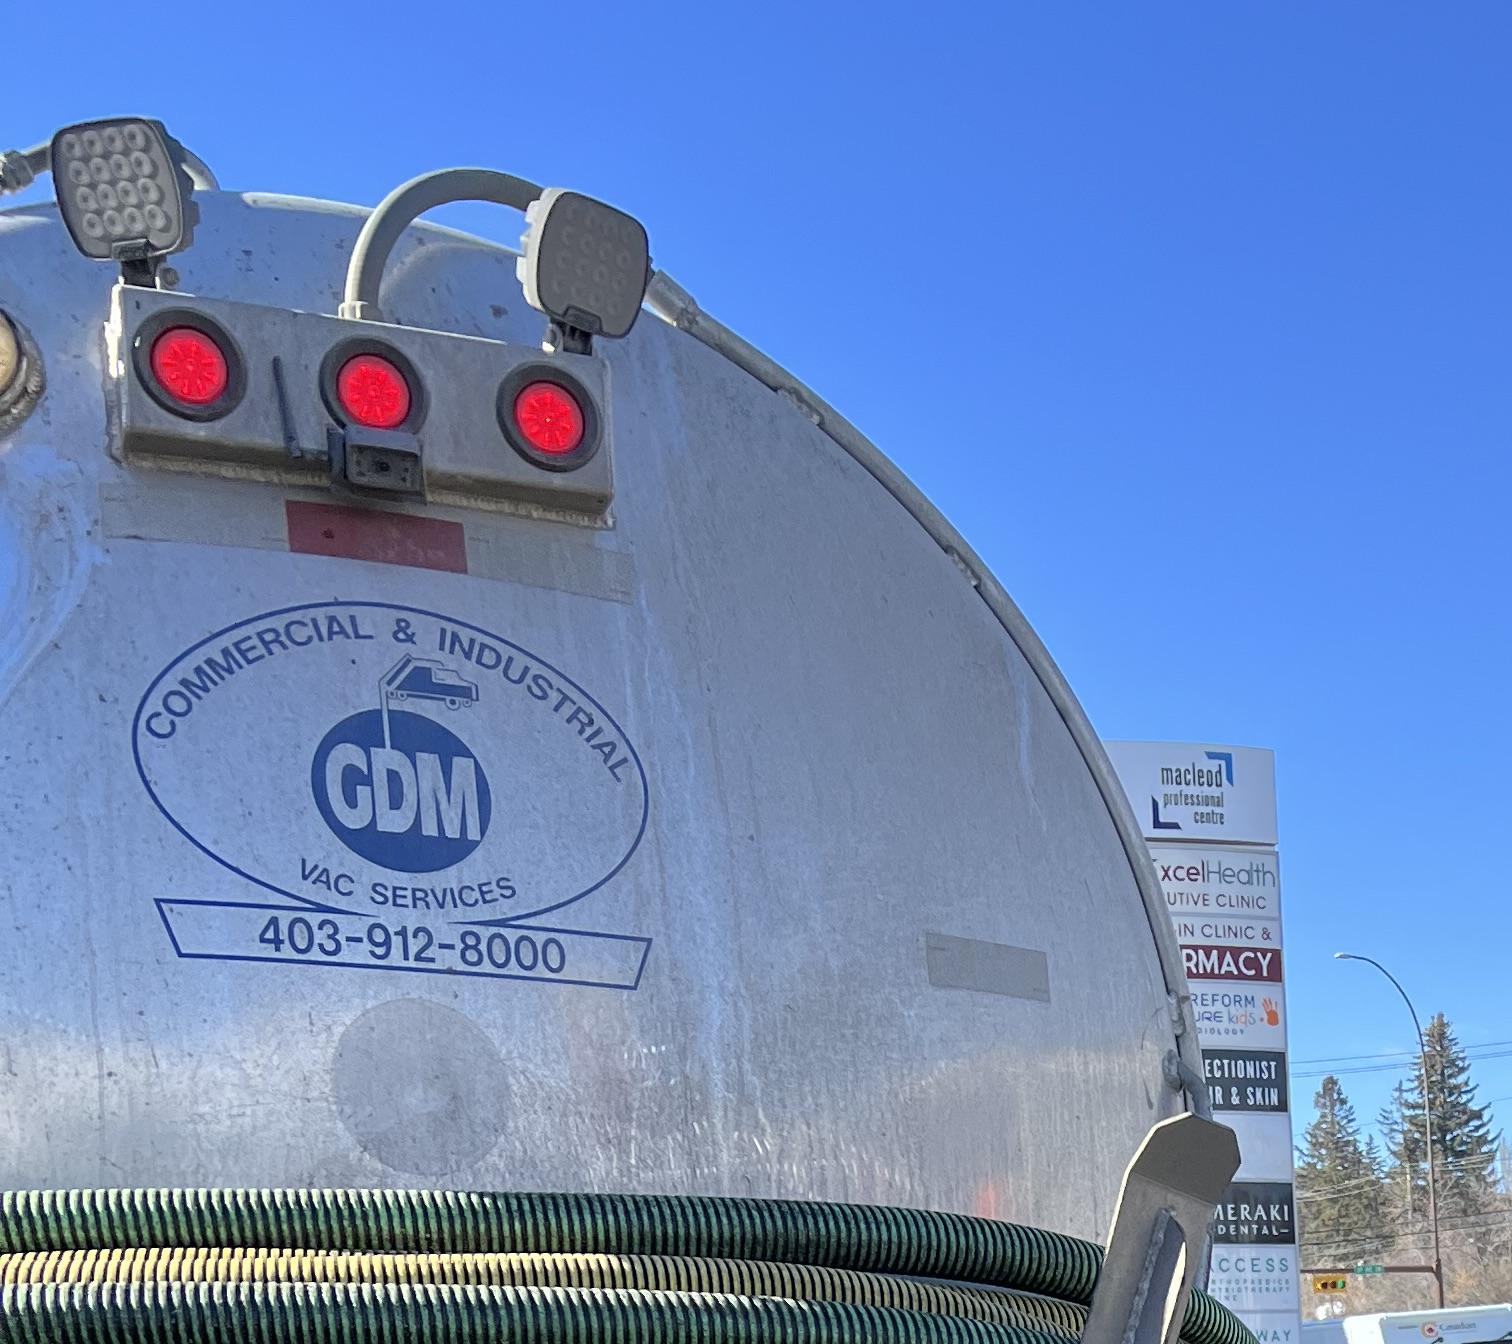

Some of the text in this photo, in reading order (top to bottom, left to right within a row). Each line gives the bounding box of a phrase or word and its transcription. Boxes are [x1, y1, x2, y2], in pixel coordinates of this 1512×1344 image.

[144, 614, 636, 783] COMMERCIAL & INDUSTRIAL
[1160, 762, 1223, 788] macleod
[324, 742, 483, 842] GDM
[1163, 790, 1225, 808] professional
[1194, 811, 1225, 825] centre
[299, 857, 518, 911] VAC SERVICES
[1152, 858, 1276, 888] xcelHealth
[1215, 893, 1267, 910] CLINIC
[1201, 923, 1256, 940] CLINIC
[1261, 927, 1272, 941] &
[258, 916, 566, 975] 403-912-8000
[1230, 1086, 1241, 1105] &
[1246, 1086, 1279, 1106] SKIN
[1211, 1257, 1289, 1273] CCESS
